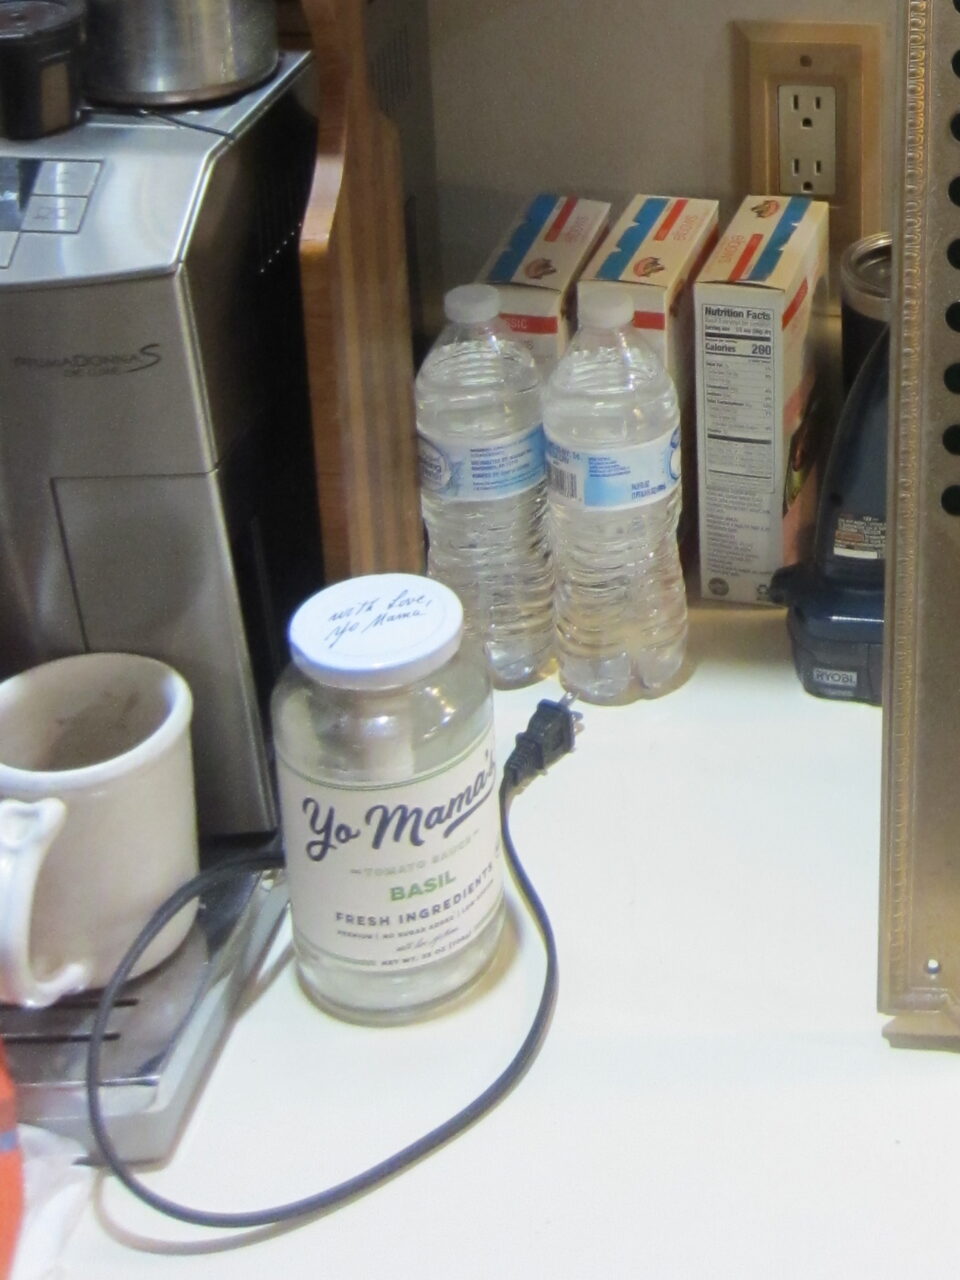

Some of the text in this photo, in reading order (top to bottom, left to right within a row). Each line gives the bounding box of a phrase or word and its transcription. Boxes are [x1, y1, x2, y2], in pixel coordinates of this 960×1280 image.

[705, 306, 772, 320] Nutrition Facts
[705, 342, 736, 353] Calories
[302, 749, 496, 862] Yo Mama's
[335, 911, 390, 927] FRESH
[398, 861, 493, 925] INGREDIENTS
[389, 870, 457, 902] BASIL
